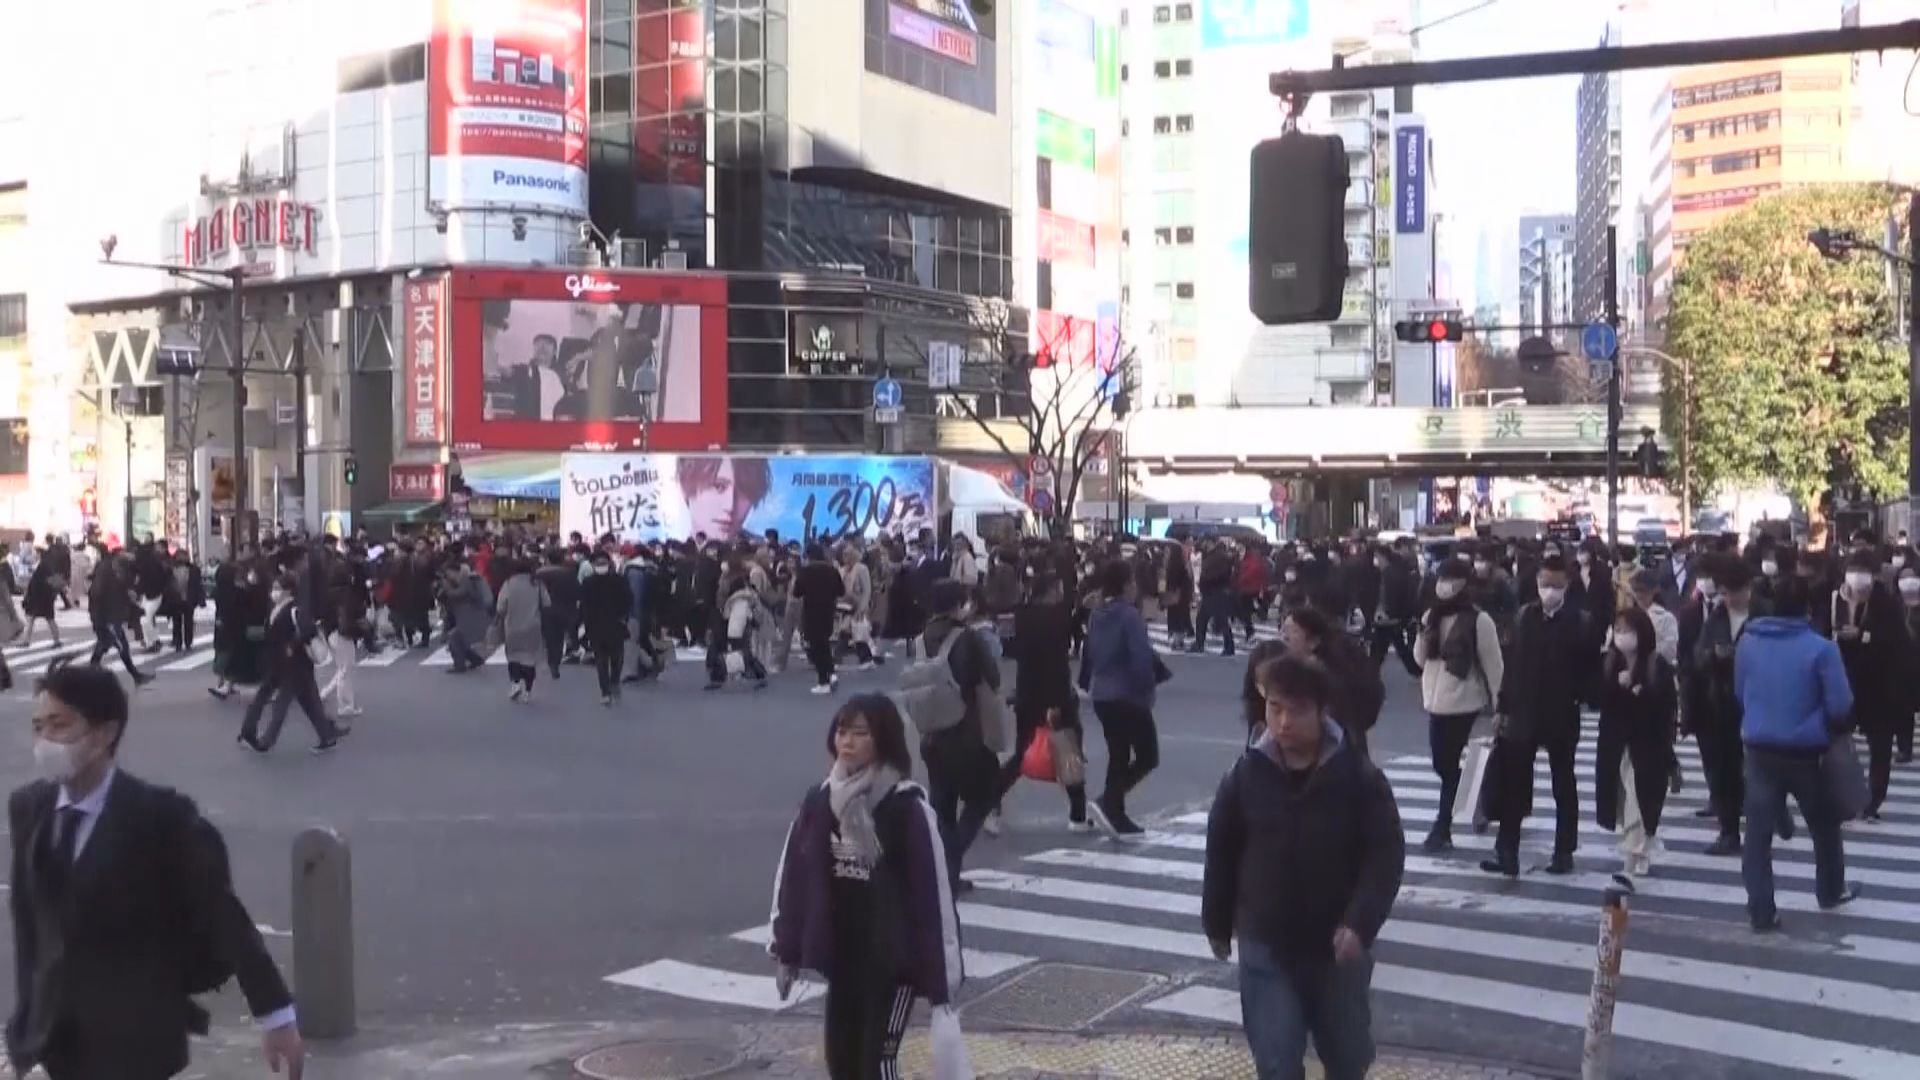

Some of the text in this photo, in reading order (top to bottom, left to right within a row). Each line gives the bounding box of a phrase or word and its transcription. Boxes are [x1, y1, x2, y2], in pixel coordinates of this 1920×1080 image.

[493, 170, 572, 195] Panasonic
[184, 200, 323, 266] MAGNET
[801, 350, 847, 362] COFFEE
[414, 305, 435, 438] 天津甘栗
[832, 861, 871, 881] didas
